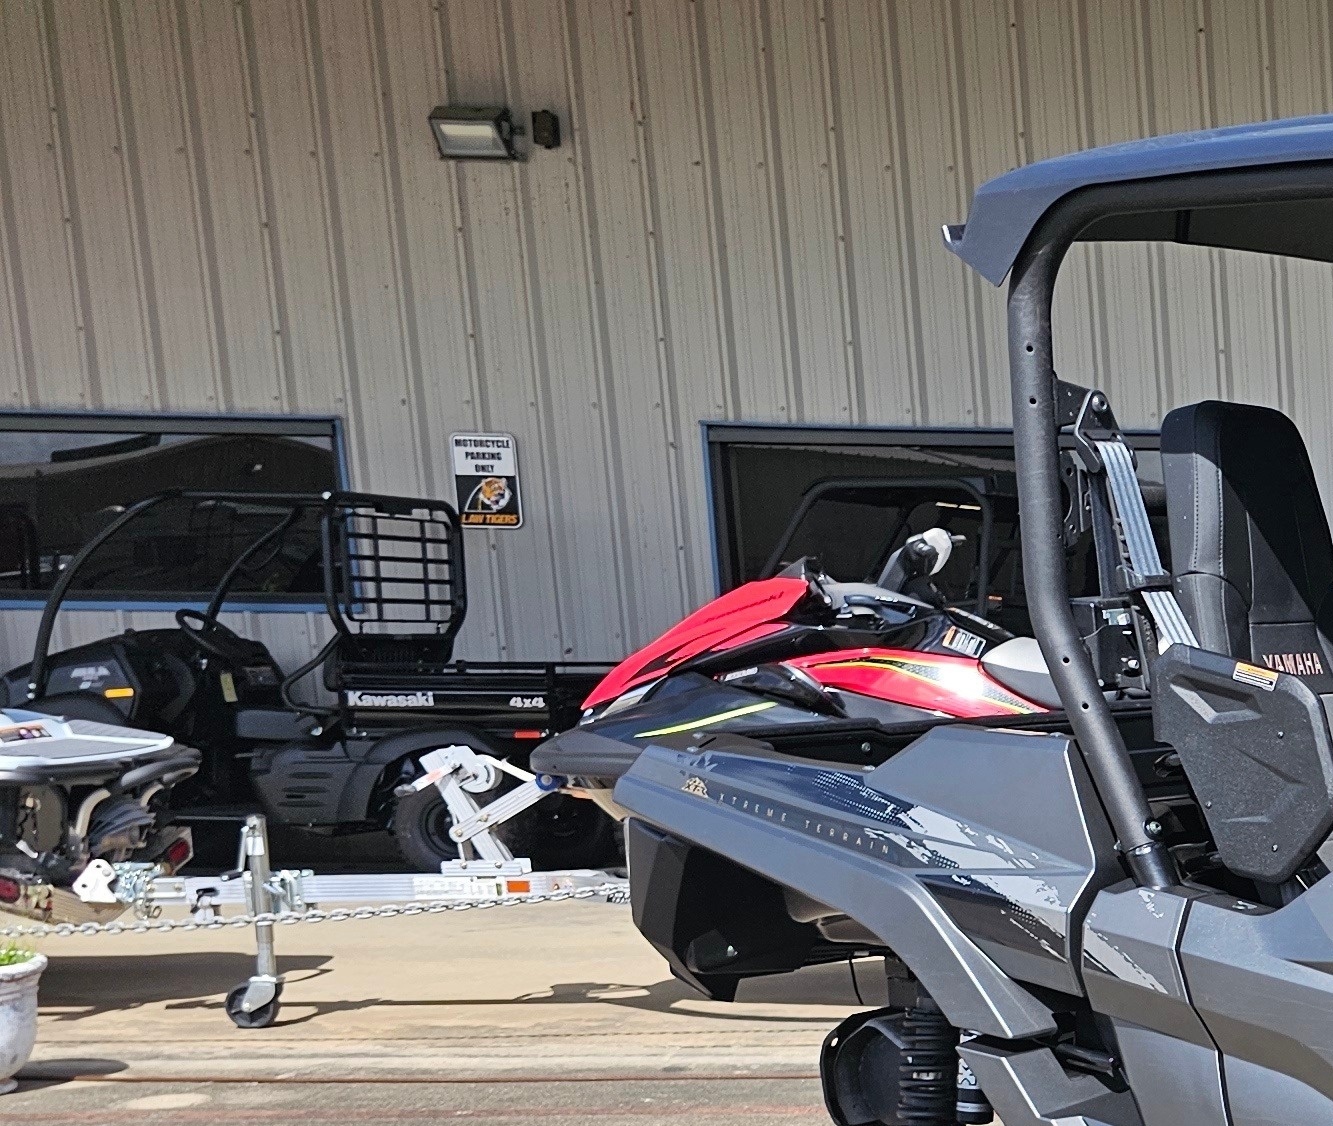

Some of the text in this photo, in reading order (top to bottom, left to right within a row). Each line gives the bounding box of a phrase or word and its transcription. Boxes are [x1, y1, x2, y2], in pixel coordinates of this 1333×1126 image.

[455, 439, 509, 448] MOTORCYCLE
[465, 452, 502, 460] PARKING
[475, 464, 494, 473] ONLY
[485, 514, 518, 524] TIGERS
[1262, 653, 1323, 675] YAMAHA
[348, 692, 434, 706] Kawasaki
[509, 696, 545, 708] 4x4
[719, 793, 889, 854] XTREME TERRAIN
